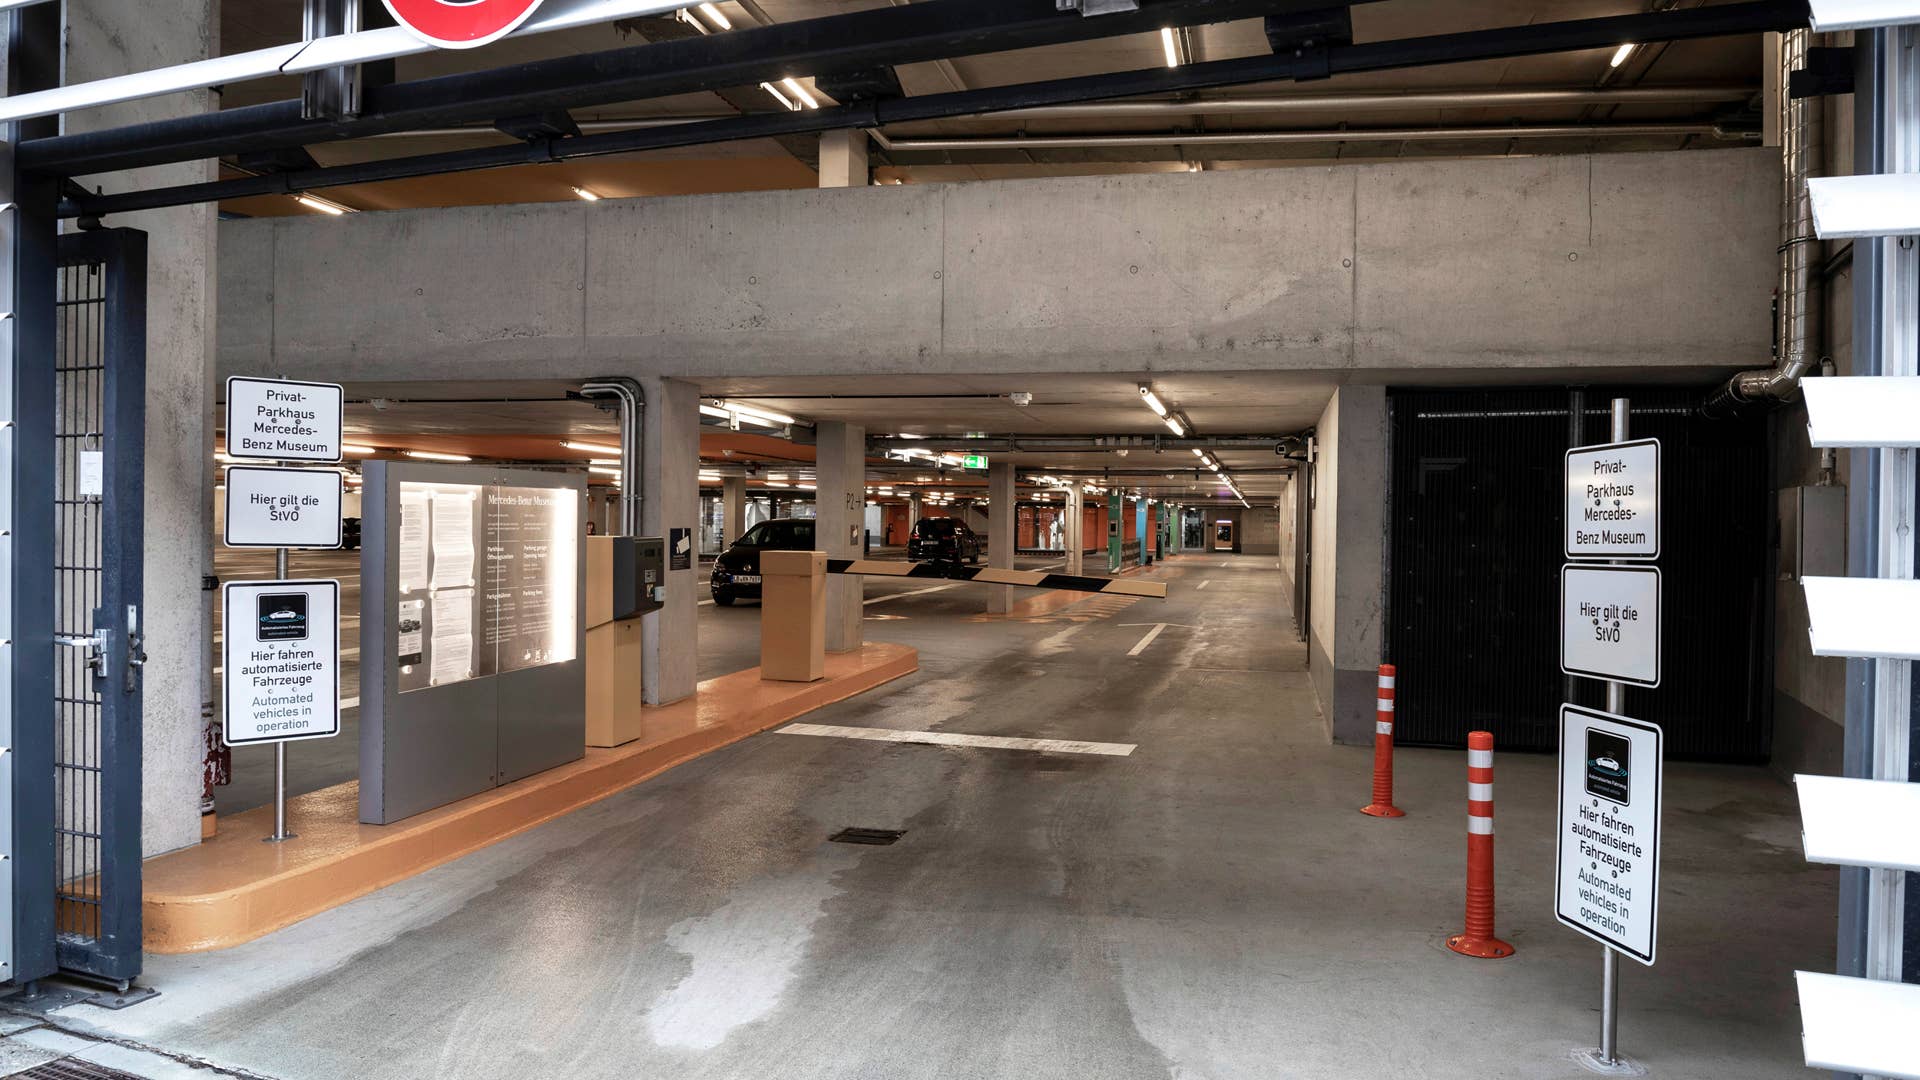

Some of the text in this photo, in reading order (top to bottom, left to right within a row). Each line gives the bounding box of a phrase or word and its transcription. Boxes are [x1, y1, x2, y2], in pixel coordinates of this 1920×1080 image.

[266, 389, 307, 402] Privat-
[257, 405, 315, 420] Parkhaus
[253, 421, 318, 436] Mercedes-
[242, 437, 328, 453] Benz Museum
[1594, 459, 1627, 475] Privat-
[1587, 482, 1634, 499] Parkhaus
[250, 493, 319, 508] Hier gilt die
[270, 510, 300, 522] StVO
[1584, 505, 1637, 522] Mercedes-
[1576, 529, 1646, 545] Benz Museum
[1580, 602, 1638, 622] Hier gilt die
[1595, 626, 1620, 643] StVO
[251, 649, 314, 661] Hier fahren
[241, 660, 323, 675] automatisierte
[253, 675, 313, 687] Fahrzeuge
[252, 692, 314, 707] Automated
[253, 706, 312, 719] vehicles in
[256, 720, 309, 734] operation
[1579, 804, 1634, 836] Hier fahren
[1571, 822, 1642, 858] automatisierte
[1580, 840, 1632, 874] Fahrzeuge
[1578, 867, 1632, 902] Automated
[1578, 887, 1629, 919] vehicles in
[1580, 906, 1626, 937] operation
